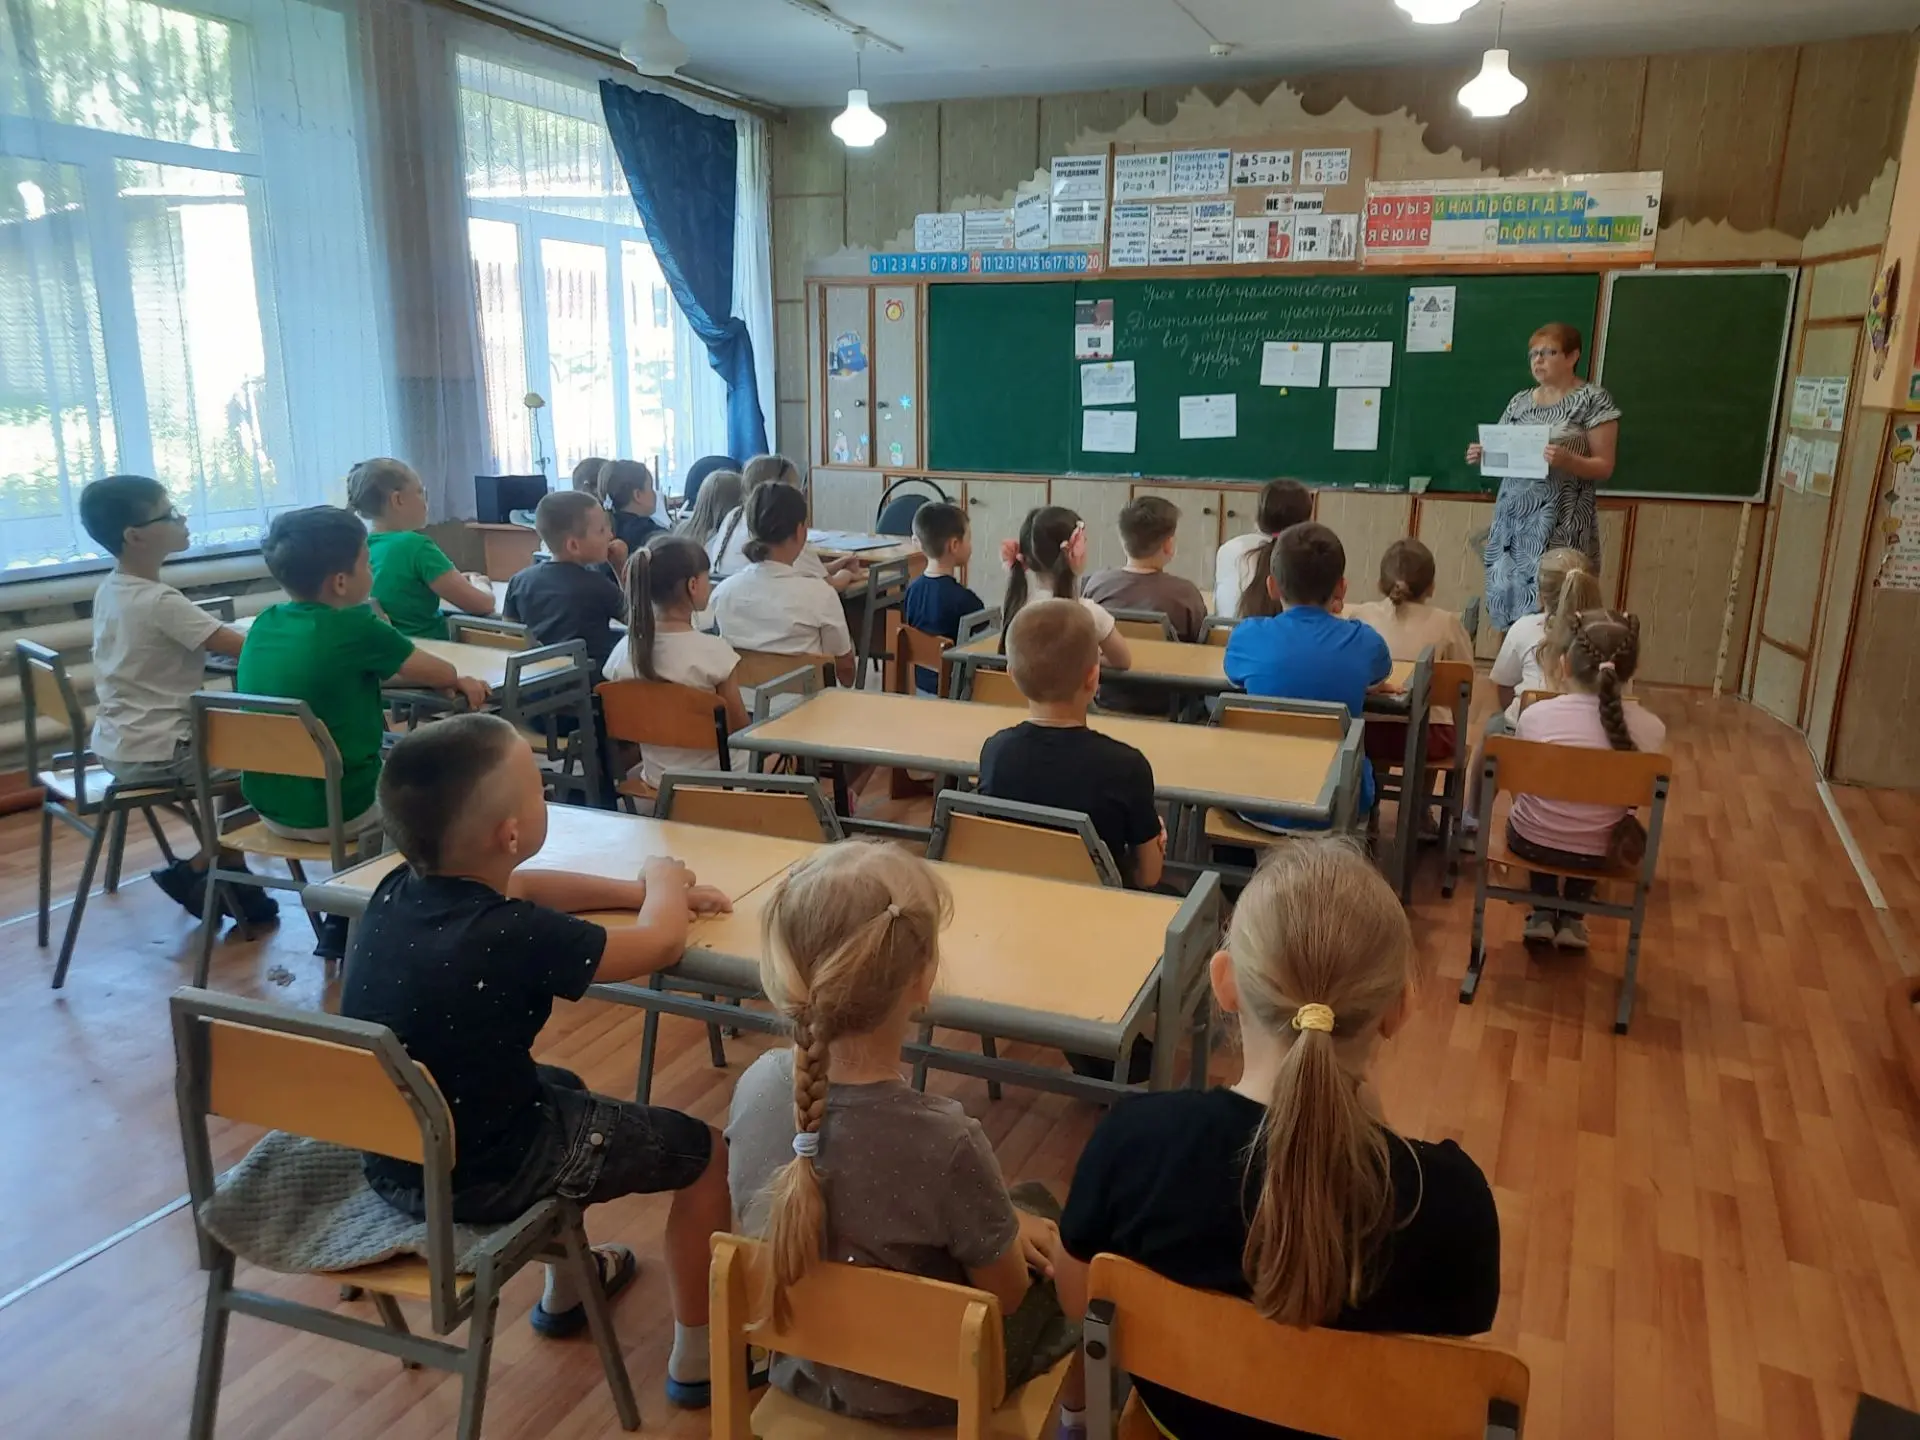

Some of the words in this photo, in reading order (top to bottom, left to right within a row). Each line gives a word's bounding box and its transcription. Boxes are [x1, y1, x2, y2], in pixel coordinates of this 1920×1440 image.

[1143, 284, 1175, 310] Урок
[1163, 329, 1188, 358] вид
[1200, 322, 1379, 360] террористической
